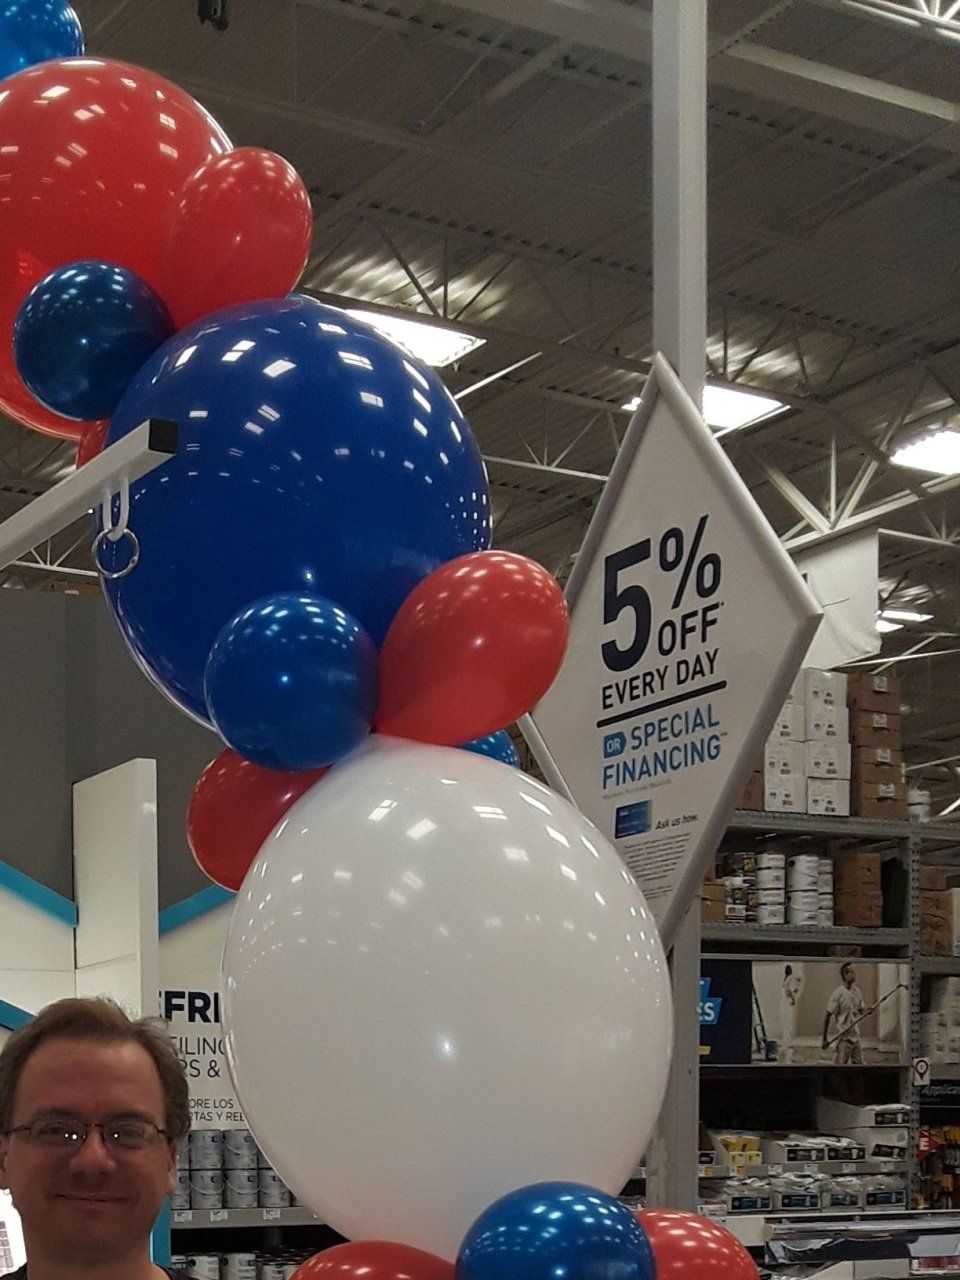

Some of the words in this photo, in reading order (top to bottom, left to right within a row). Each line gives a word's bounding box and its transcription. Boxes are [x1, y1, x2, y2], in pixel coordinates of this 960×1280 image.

[601, 514, 721, 672] 5%
[602, 665, 668, 711] EVERY
[677, 647, 720, 685] DAY
[607, 737, 621, 753] OR
[631, 703, 720, 751] SPECIAL
[603, 734, 723, 790] FINANCING
[655, 819, 670, 830] Ask
[207, 1059, 220, 1078] &
[213, 1099, 234, 1109] LOS
[216, 1111, 224, 1122] Y
